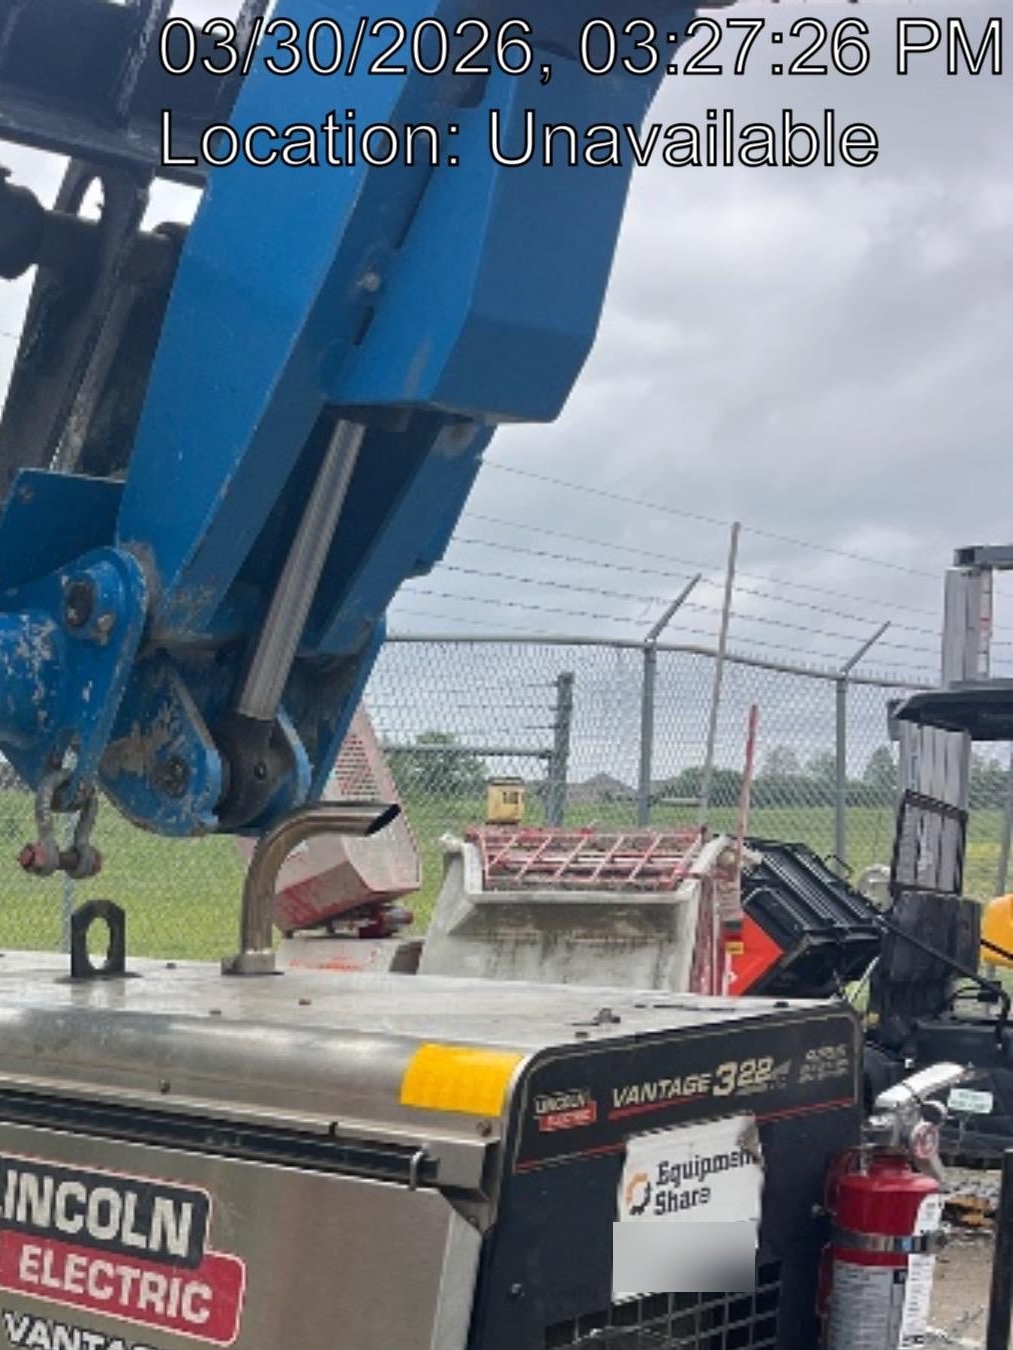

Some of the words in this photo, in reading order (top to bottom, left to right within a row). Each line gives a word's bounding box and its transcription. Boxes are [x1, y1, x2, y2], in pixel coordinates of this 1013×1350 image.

[612, 1073, 712, 1108] VANTAGE
[654, 1187, 711, 1215] Share
[18, 1242, 214, 1325] ELECTRIC
